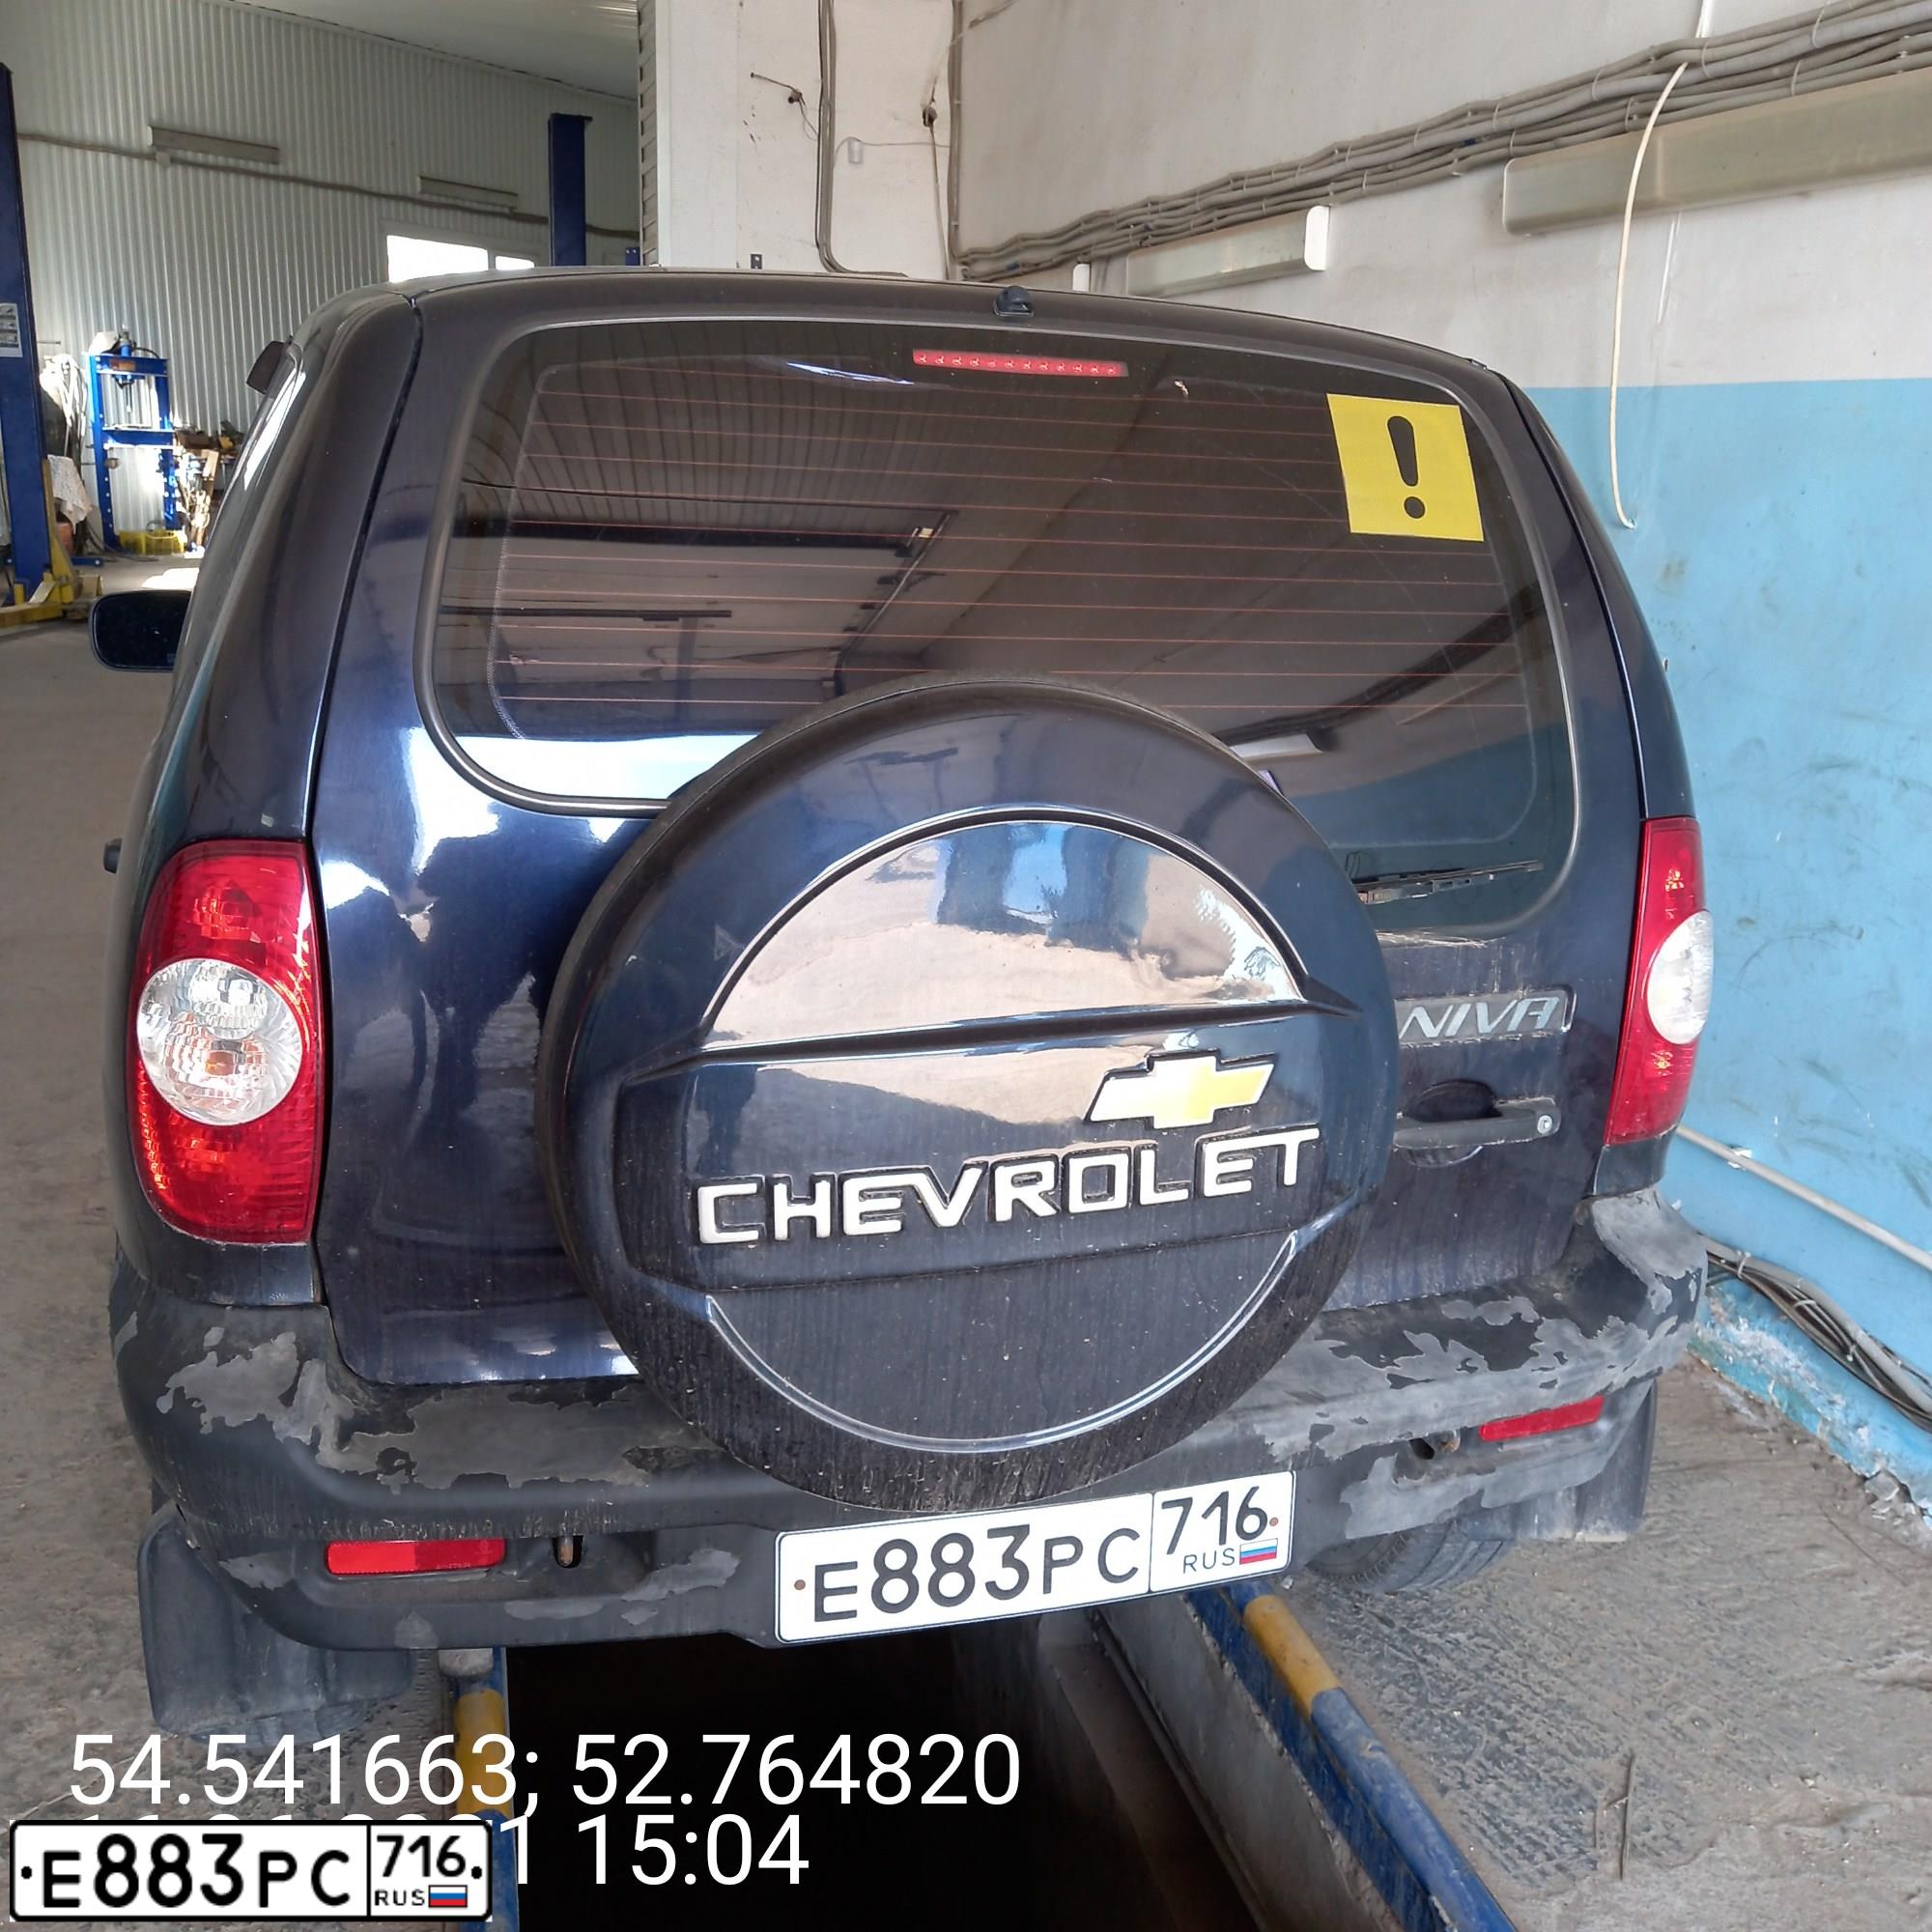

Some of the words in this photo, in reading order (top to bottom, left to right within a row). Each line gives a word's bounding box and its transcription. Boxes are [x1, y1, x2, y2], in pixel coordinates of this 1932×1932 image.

[1398, 996, 1560, 1039] NIVA
[697, 1127, 1320, 1245] CHEVROLET
[1160, 1486, 1268, 1555] 716
[1182, 1548, 1236, 1575] RUS
